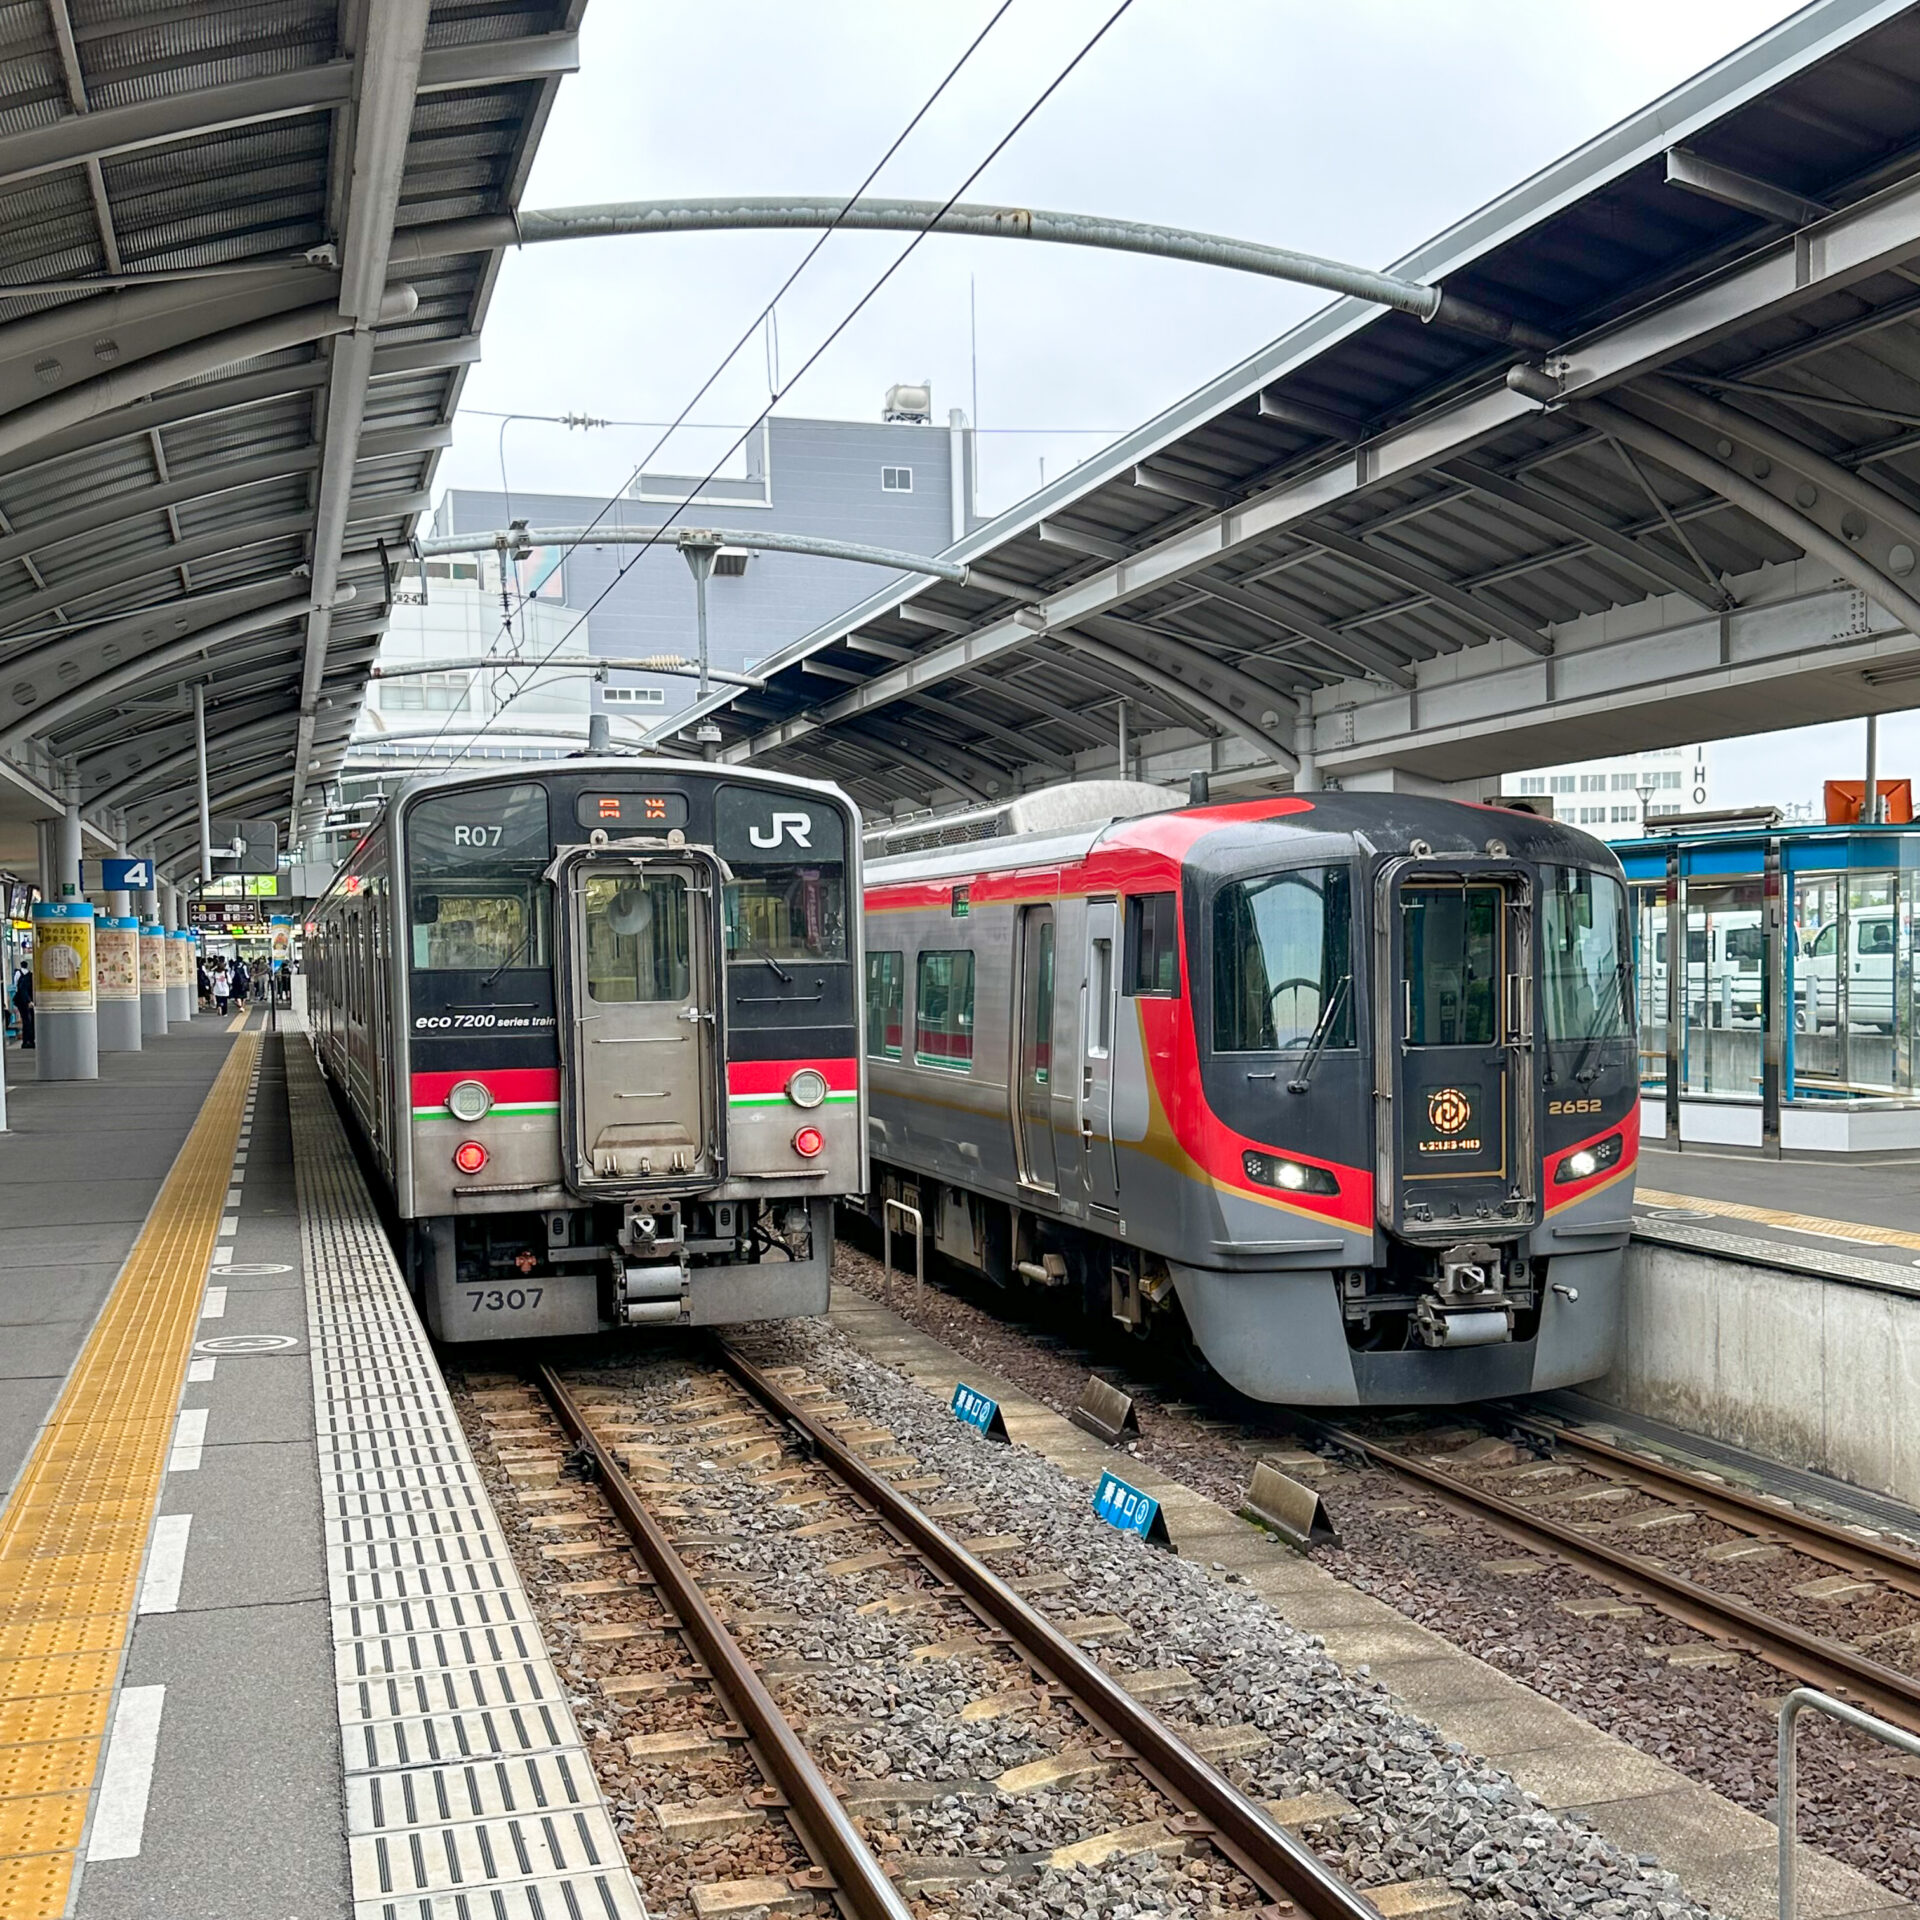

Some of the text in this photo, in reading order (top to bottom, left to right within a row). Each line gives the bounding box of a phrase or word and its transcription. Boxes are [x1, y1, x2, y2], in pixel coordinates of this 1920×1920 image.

[454, 826, 503, 847] R07
[749, 812, 812, 848] JR
[124, 862, 148, 887] 4
[51, 905, 67, 914] JR
[107, 918, 119, 926] JR
[415, 1014, 556, 1029] eco 7200 series train
[1549, 1099, 1602, 1115] 2652
[466, 1288, 544, 1313] 7307
